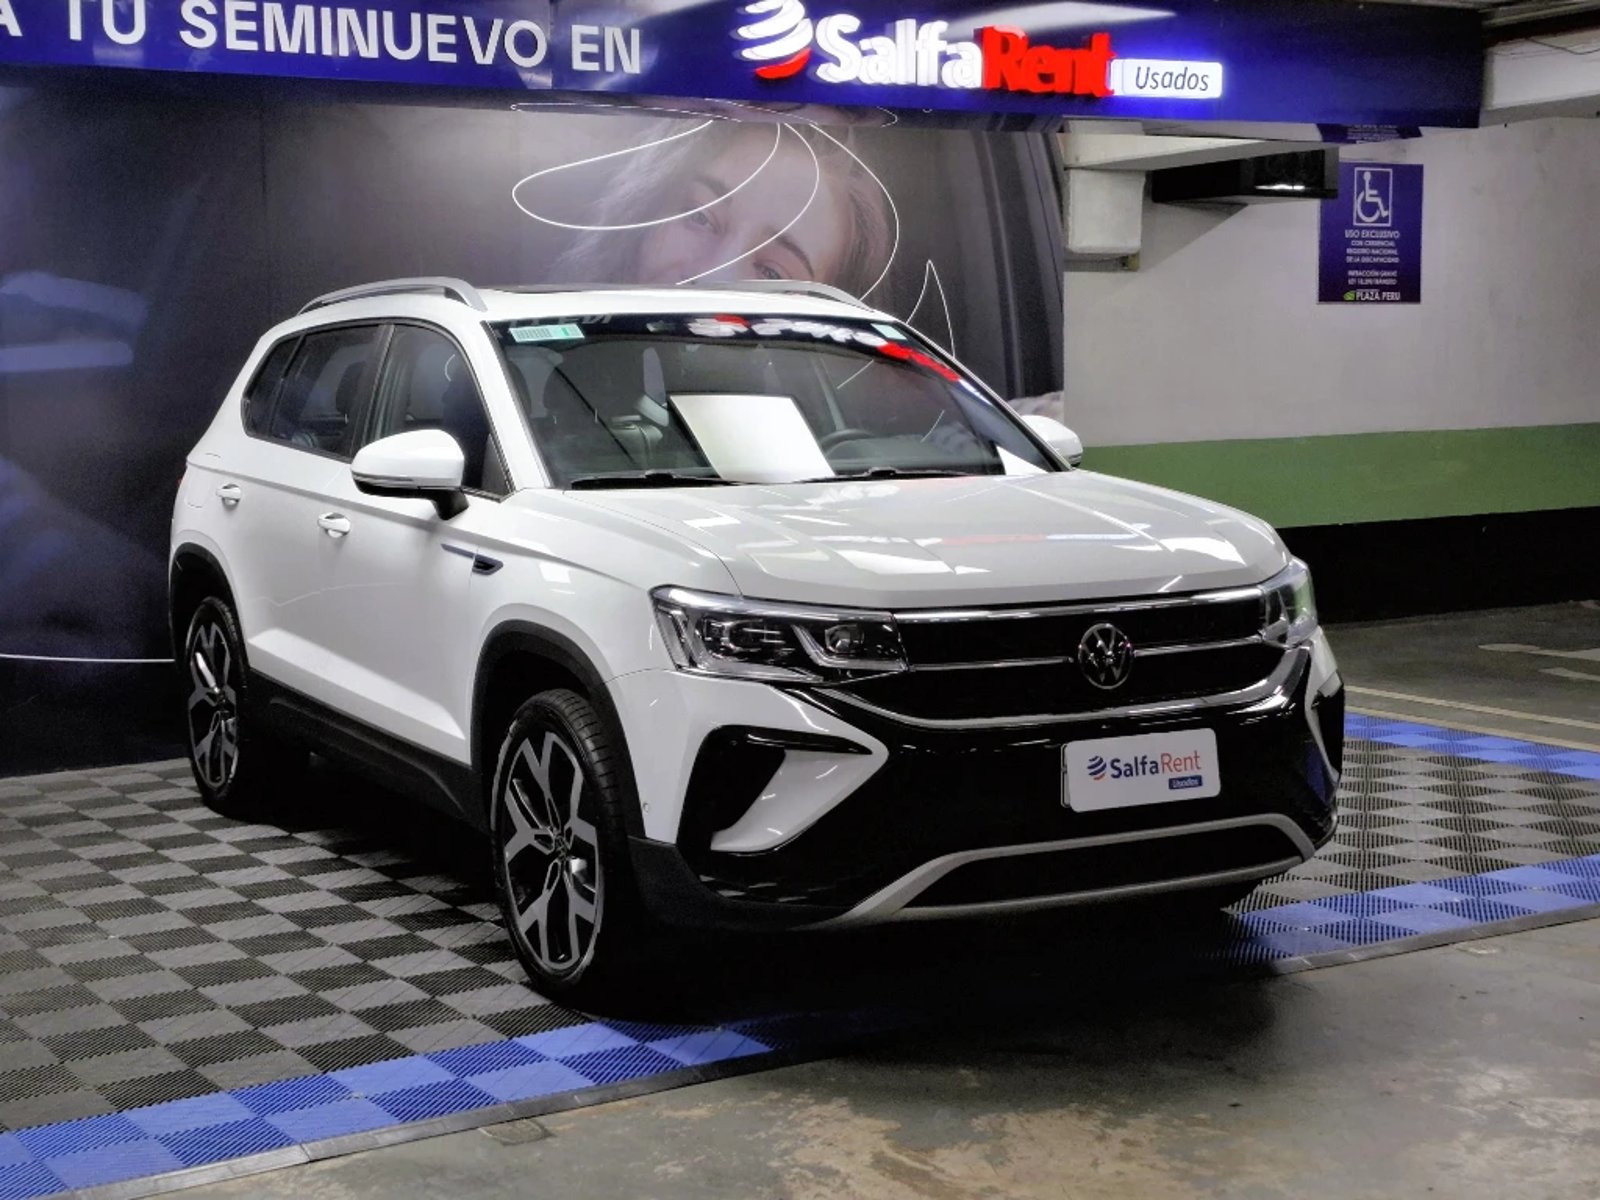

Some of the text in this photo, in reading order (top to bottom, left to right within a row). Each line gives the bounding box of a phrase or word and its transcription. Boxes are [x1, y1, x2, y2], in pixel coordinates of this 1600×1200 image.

[179, 0, 548, 68] SEMINUEVO
[571, 25, 642, 74] EN
[814, 14, 1116, 98] SalfaRent
[1134, 65, 1210, 92] Usados
[1356, 291, 1380, 301] PLAZA
[1110, 751, 1202, 779] SalfaRent
